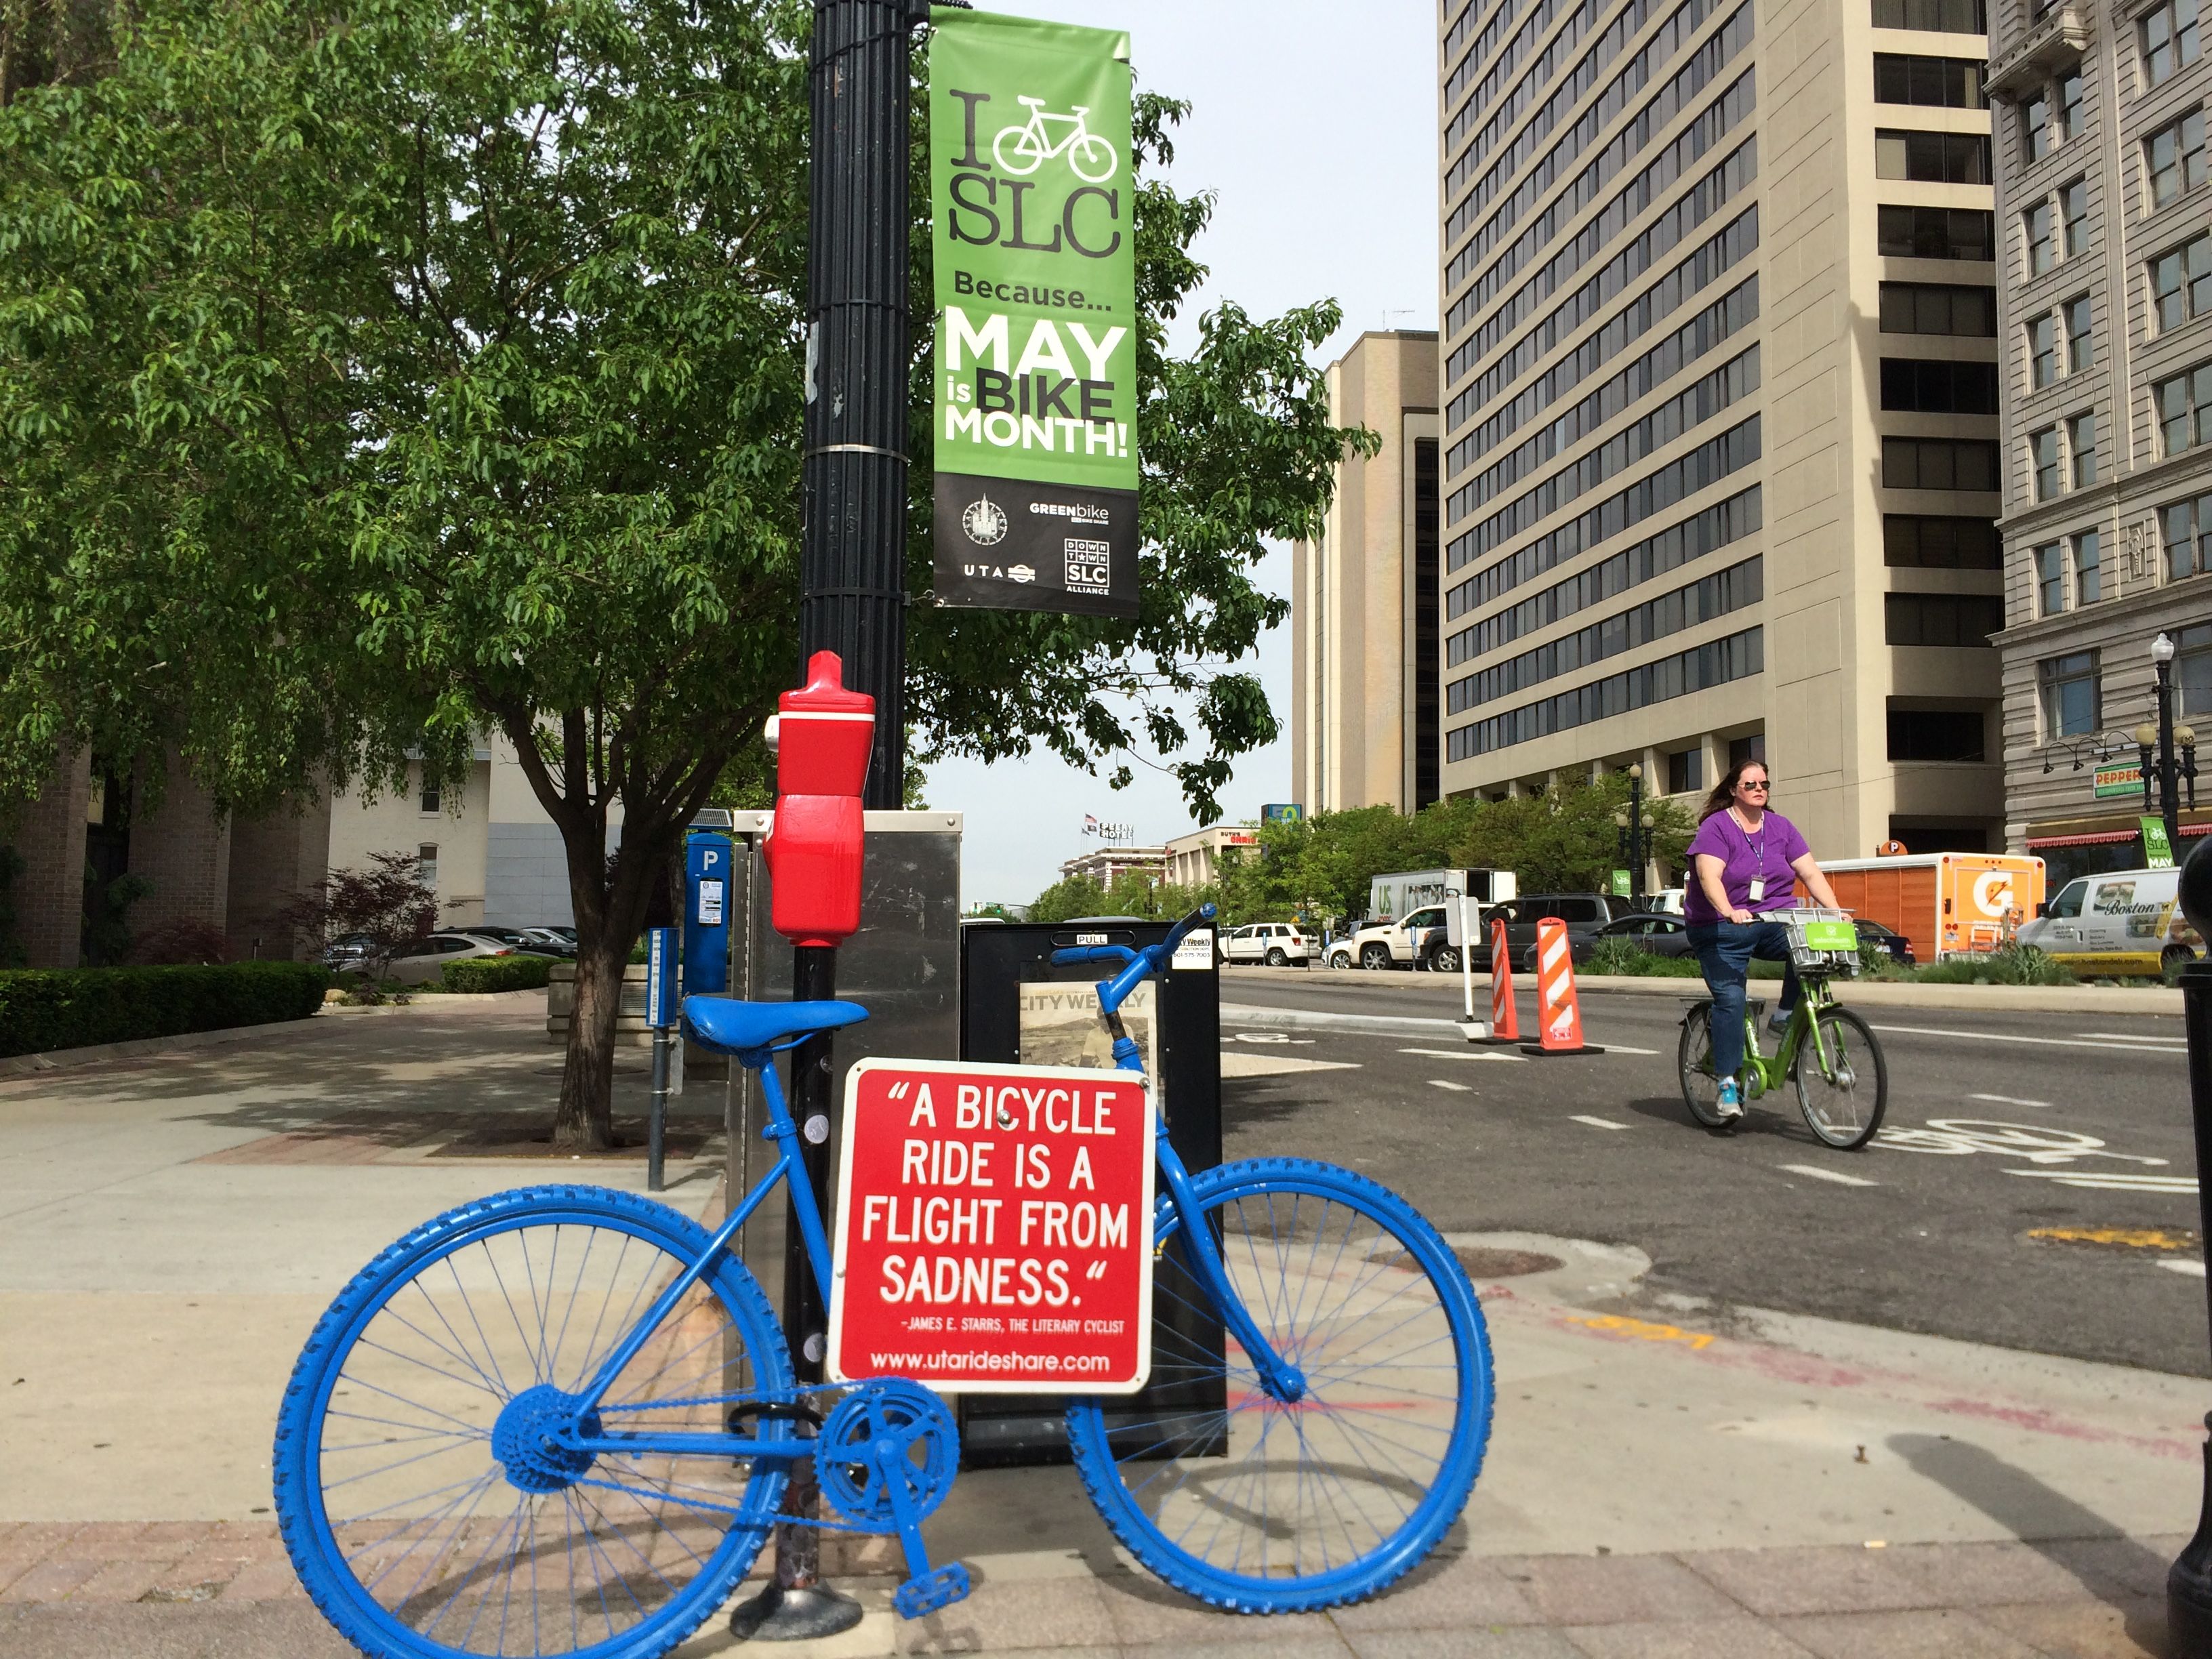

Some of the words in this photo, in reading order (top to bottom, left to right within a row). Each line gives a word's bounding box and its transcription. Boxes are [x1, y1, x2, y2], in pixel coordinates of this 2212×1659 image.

[949, 89, 991, 171] I
[949, 173, 1122, 259] SLC
[954, 271, 1112, 312] Because...
[945, 304, 1128, 386] MAY
[947, 375, 972, 403] is
[976, 367, 1115, 426] BIKE
[945, 405, 1128, 458] MONTH!
[1029, 503, 1109, 520] GREENbike
[1067, 541, 1106, 552] DOWN
[1067, 564, 1107, 583] SLC
[1066, 586, 1109, 595] ALLIANCE
[1102, 830, 1134, 839] HOTEL
[1891, 842, 1898, 853] P
[2146, 839, 2169, 851] SLC
[703, 851, 719, 871] P
[2148, 857, 2173, 868] MAY
[1973, 872, 2013, 918] G
[2104, 899, 2155, 916] Boston
[1187, 938, 1211, 947] Weekly
[1019, 994, 1063, 1010] CITY
[1066, 992, 1146, 1009] WELY
[956, 1084, 1117, 1135] BICYCLE
[902, 1139, 995, 1187] RIDE
[1015, 1143, 1051, 1189] IS
[1068, 1145, 1095, 1191] A
[862, 1195, 1003, 1246] FLIGHT
[1020, 1200, 1128, 1249] FROM
[946, 1317, 958, 1332] E.
[961, 1317, 1006, 1335] STARRS,
[1008, 1318, 1028, 1333] THE
[1032, 1319, 1081, 1334] LITERARY
[1084, 1319, 1125, 1334] CYCLIST
[870, 1349, 1111, 1372] www.utarideshare.com
